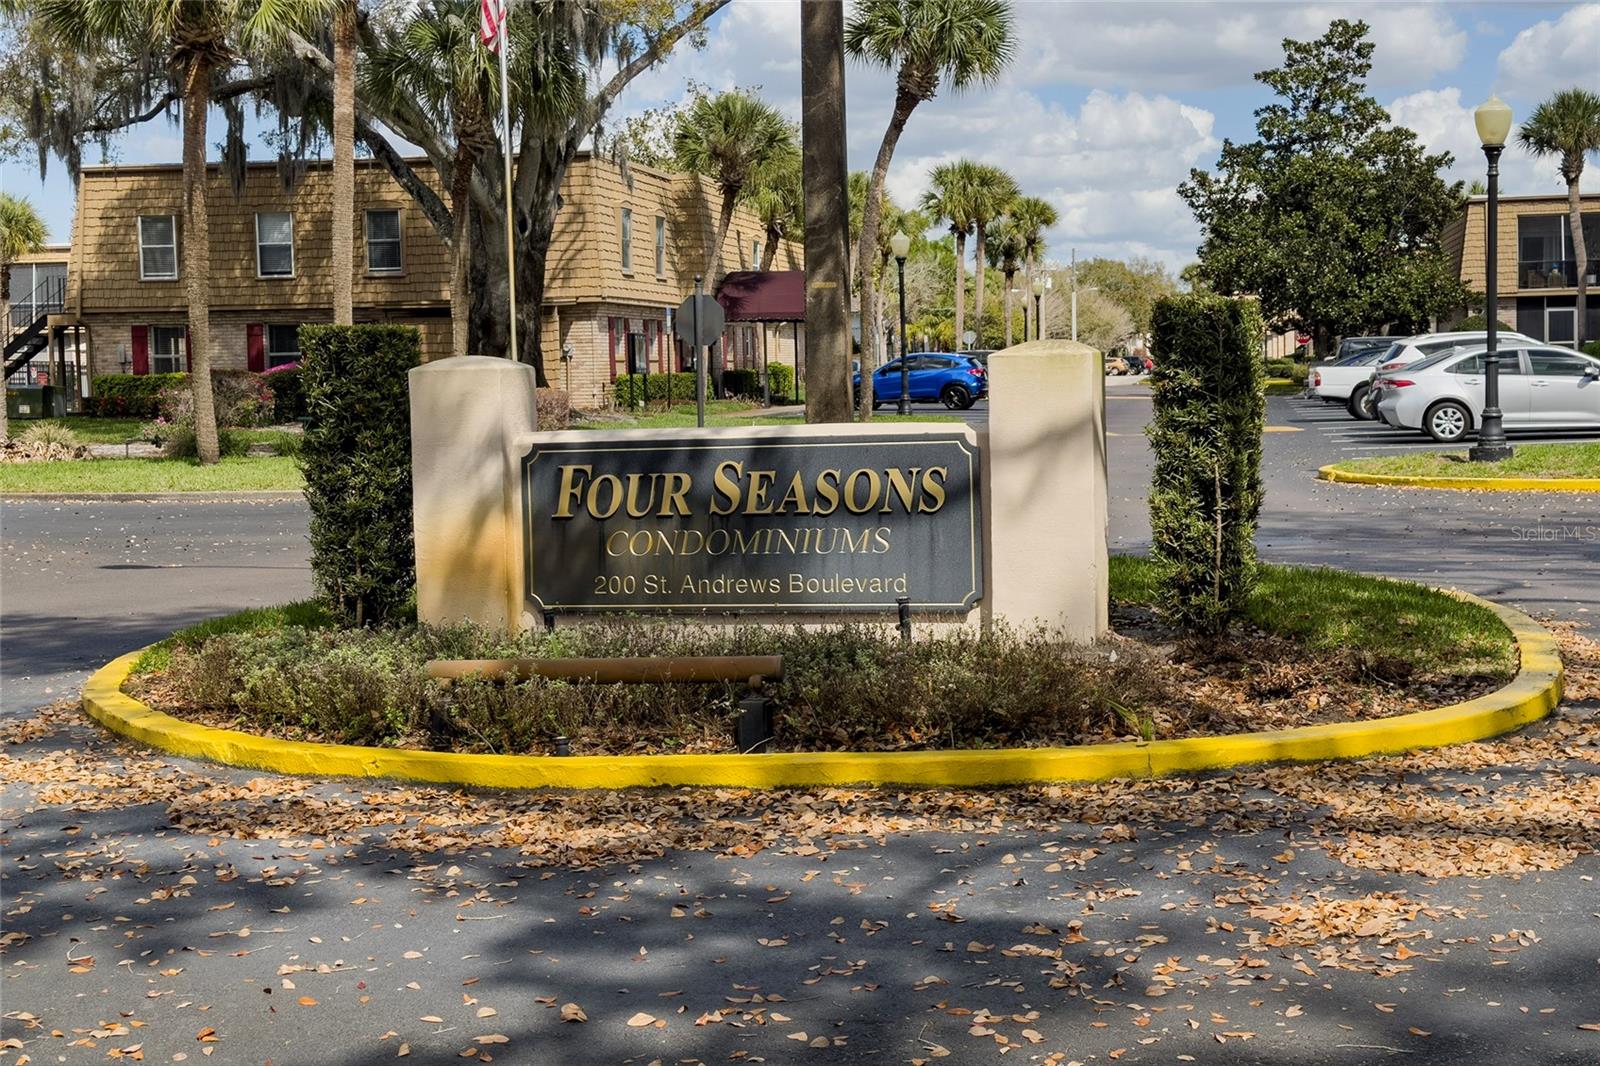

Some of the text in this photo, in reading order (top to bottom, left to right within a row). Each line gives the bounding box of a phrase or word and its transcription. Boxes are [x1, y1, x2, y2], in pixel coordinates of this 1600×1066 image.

[551, 460, 948, 519] FOUR SEASONS
[606, 527, 892, 557] CONDOMINIUMS
[594, 573, 907, 595] 200 St. Andrews Boulevard
